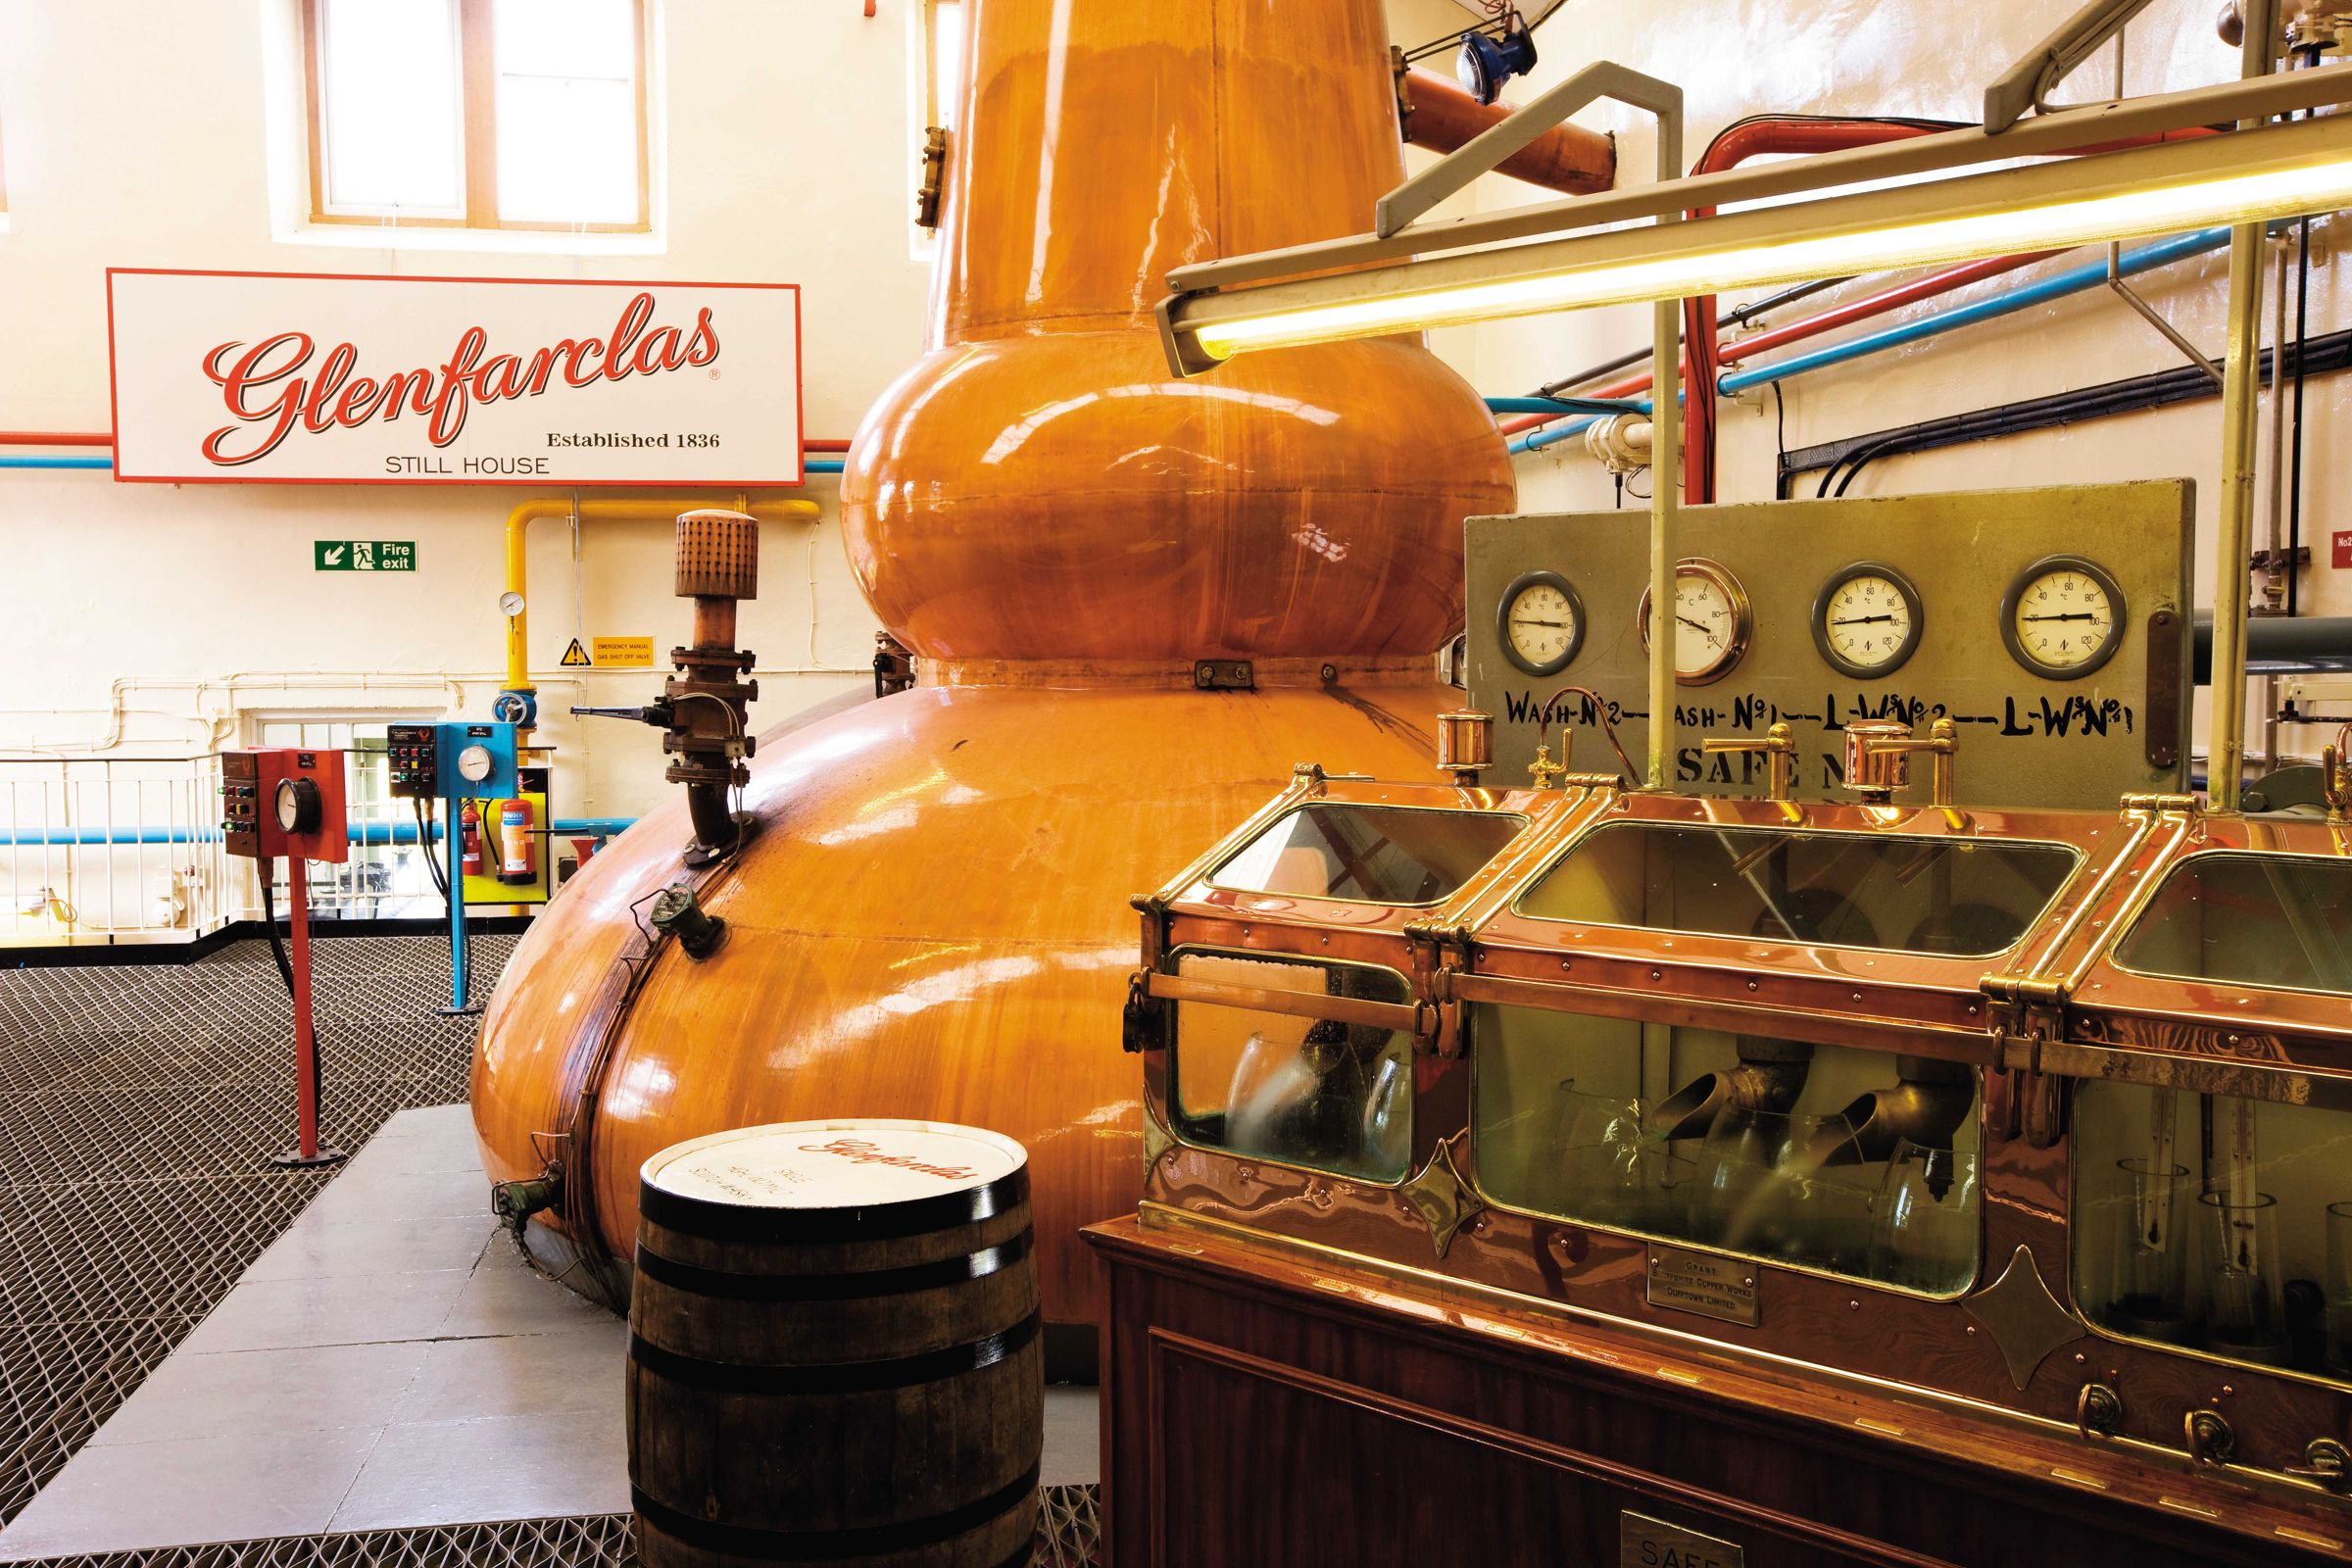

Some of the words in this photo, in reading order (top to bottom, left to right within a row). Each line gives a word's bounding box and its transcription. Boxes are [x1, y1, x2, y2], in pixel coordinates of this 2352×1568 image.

[201, 292, 720, 466] Glenfarclas
[547, 432, 669, 448] Established
[677, 434, 720, 448] 1836
[385, 456, 453, 473] STILL
[464, 457, 550, 474] HOUSE
[382, 544, 410, 556] Fire
[382, 558, 409, 568] exit
[2064, 582, 2074, 591] 60
[1889, 618, 1899, 627] 100
[2088, 617, 2100, 626] 100
[2081, 635, 2092, 644] 120
[1686, 1261, 1717, 1276] GRANT
[1652, 1268, 1693, 1285] BFFSHIRE
[1696, 1279, 1724, 1292] COPPER
[1727, 1285, 1752, 1298] WORKS
[1707, 1296, 1736, 1310] LIMITED
